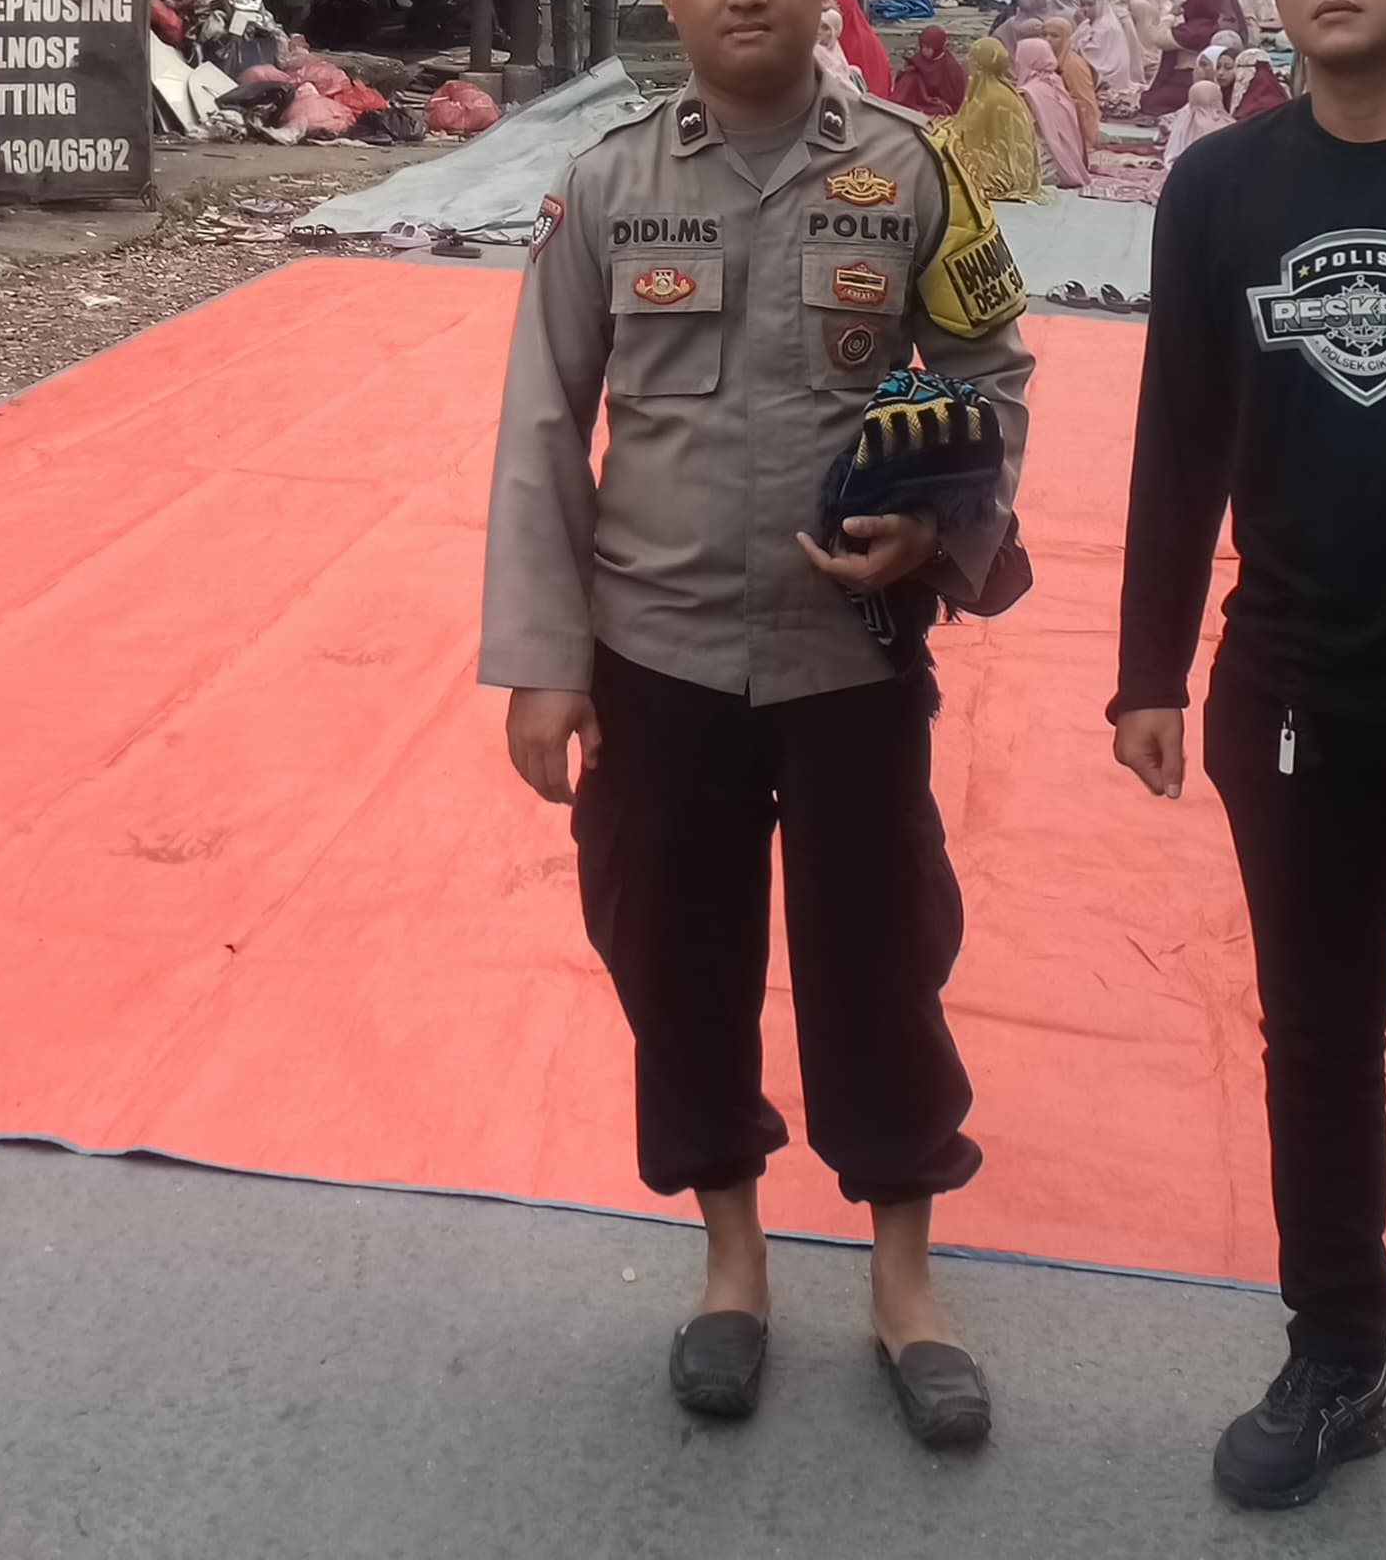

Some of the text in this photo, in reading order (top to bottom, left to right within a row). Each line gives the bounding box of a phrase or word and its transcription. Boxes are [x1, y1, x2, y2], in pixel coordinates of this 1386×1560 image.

[612, 217, 719, 246] DIDI.MS
[808, 212, 913, 243] POLRI
[1321, 345, 1365, 372] POLSEK
